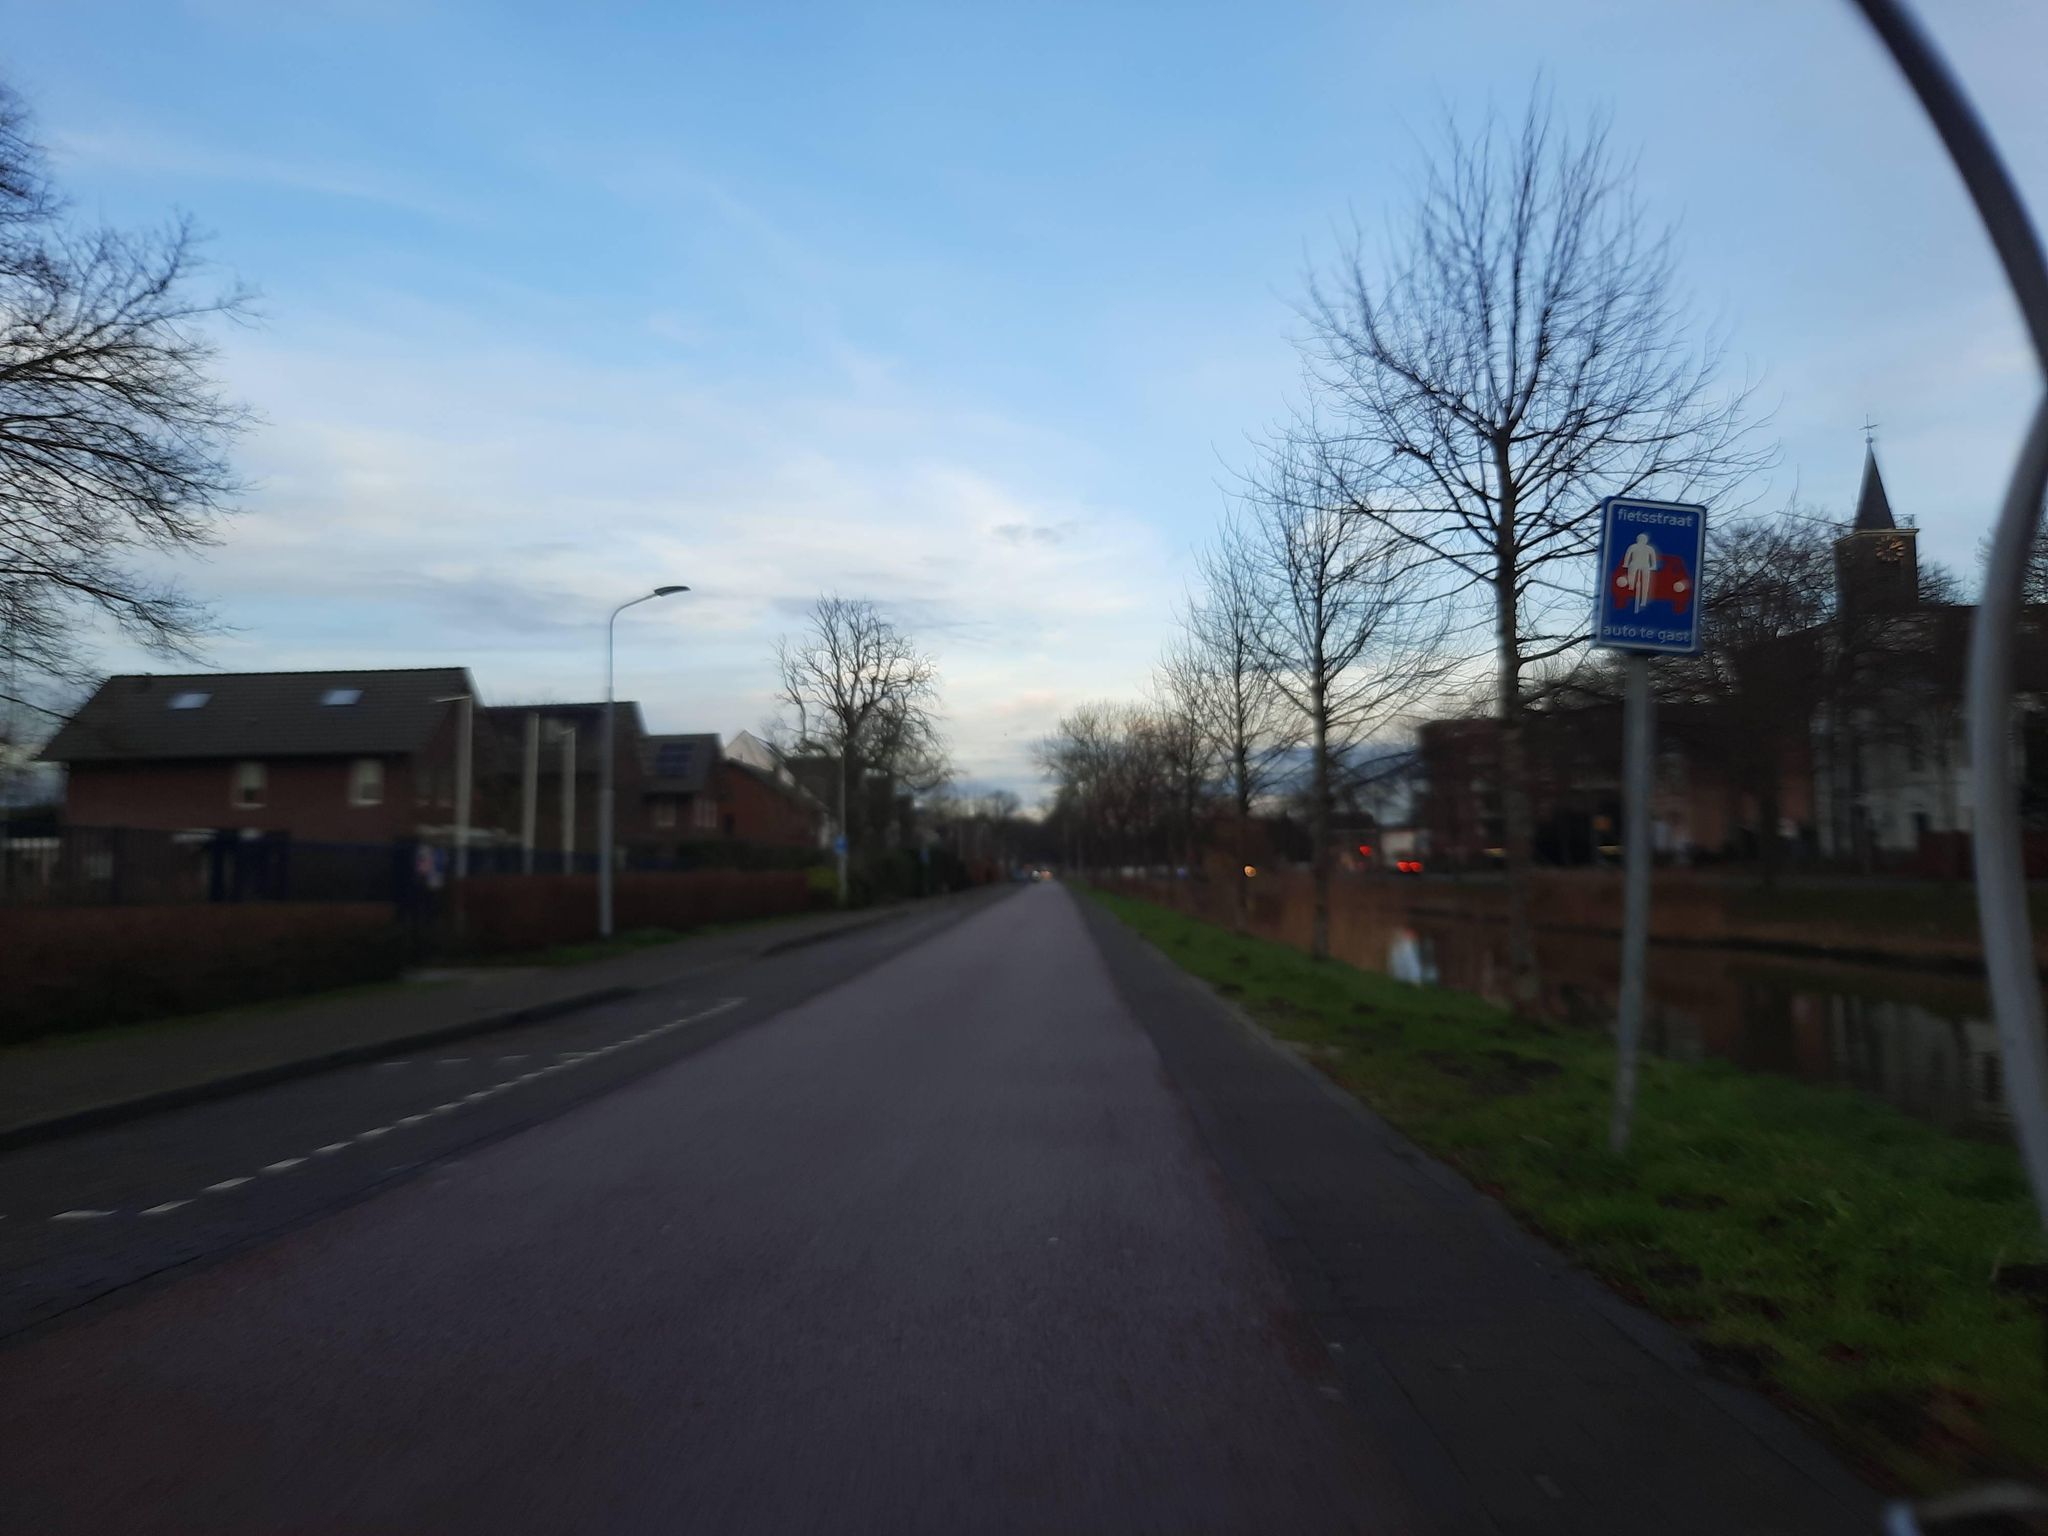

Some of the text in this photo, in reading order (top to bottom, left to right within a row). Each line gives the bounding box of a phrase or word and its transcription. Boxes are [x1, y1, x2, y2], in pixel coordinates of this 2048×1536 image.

[1617, 508, 1693, 527] fietsstraat
[1604, 625, 1691, 643] auto te gast
